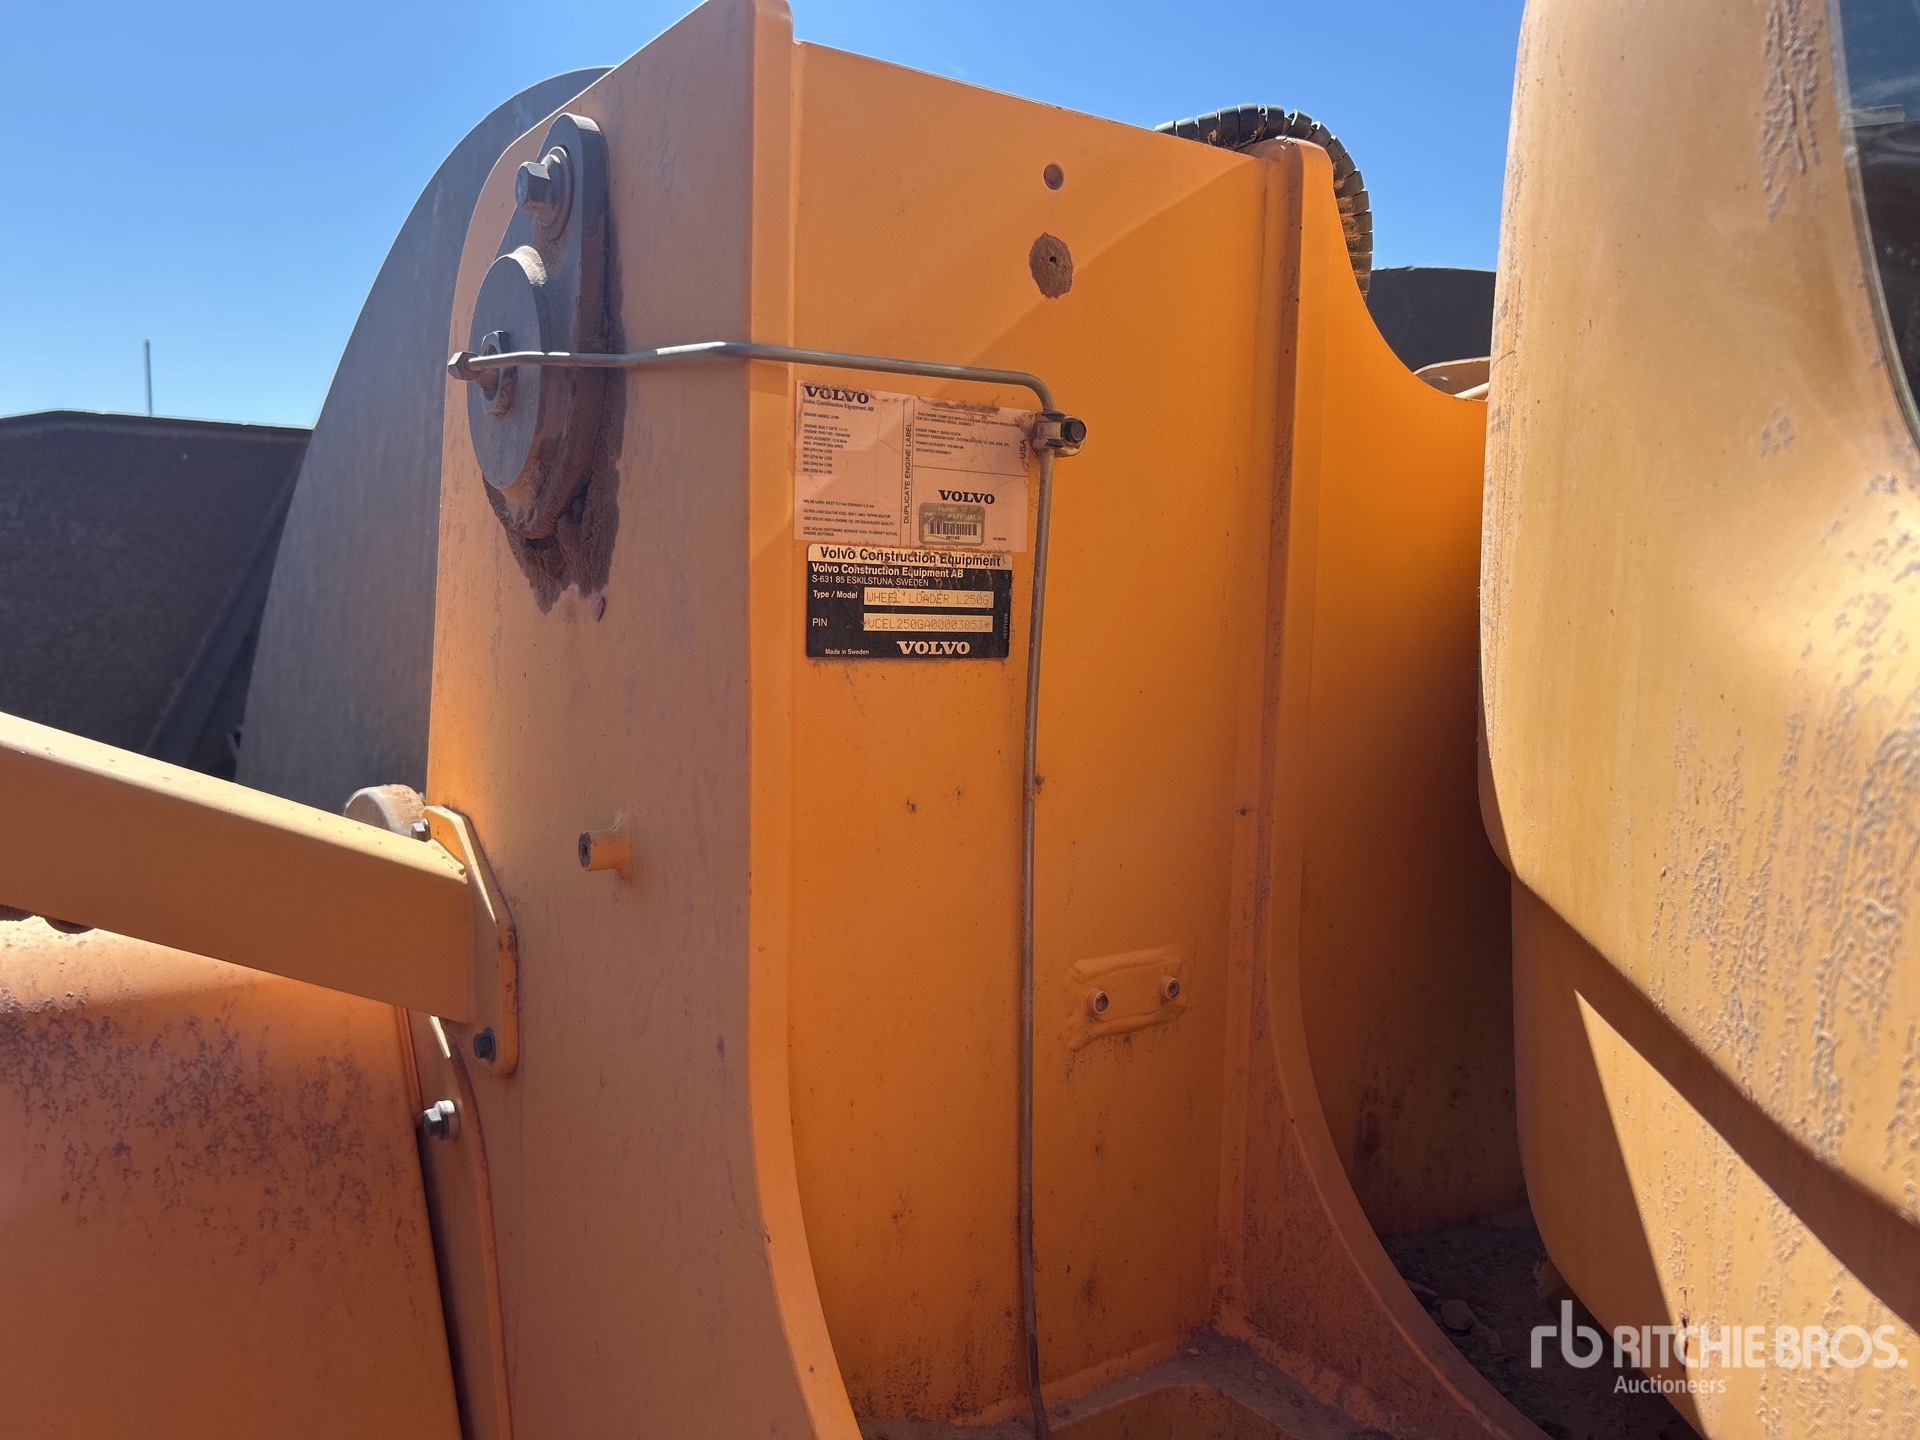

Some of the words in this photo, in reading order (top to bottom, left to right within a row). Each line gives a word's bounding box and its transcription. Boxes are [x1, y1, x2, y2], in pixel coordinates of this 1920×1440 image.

[804, 386, 869, 404] VOLVO
[817, 400, 843, 408] Construction
[938, 490, 995, 504] VOLVO
[820, 546, 856, 560] Volvo
[860, 548, 936, 564] Construction
[940, 553, 1001, 568] Equipment
[812, 563, 838, 574] Volvo
[842, 565, 900, 576] Construction
[902, 567, 949, 578] Equipment
[951, 569, 964, 578] AB
[812, 574, 833, 583] S-631
[835, 575, 844, 584] 85
[895, 577, 929, 586] SWEDEN
[813, 590, 830, 599] Type
[836, 591, 858, 599] Model
[866, 591, 900, 603] WHEEL
[909, 593, 950, 604] LOADER
[956, 594, 989, 605] L250G
[812, 618, 828, 627] PIN
[896, 641, 970, 655] VOLVO
